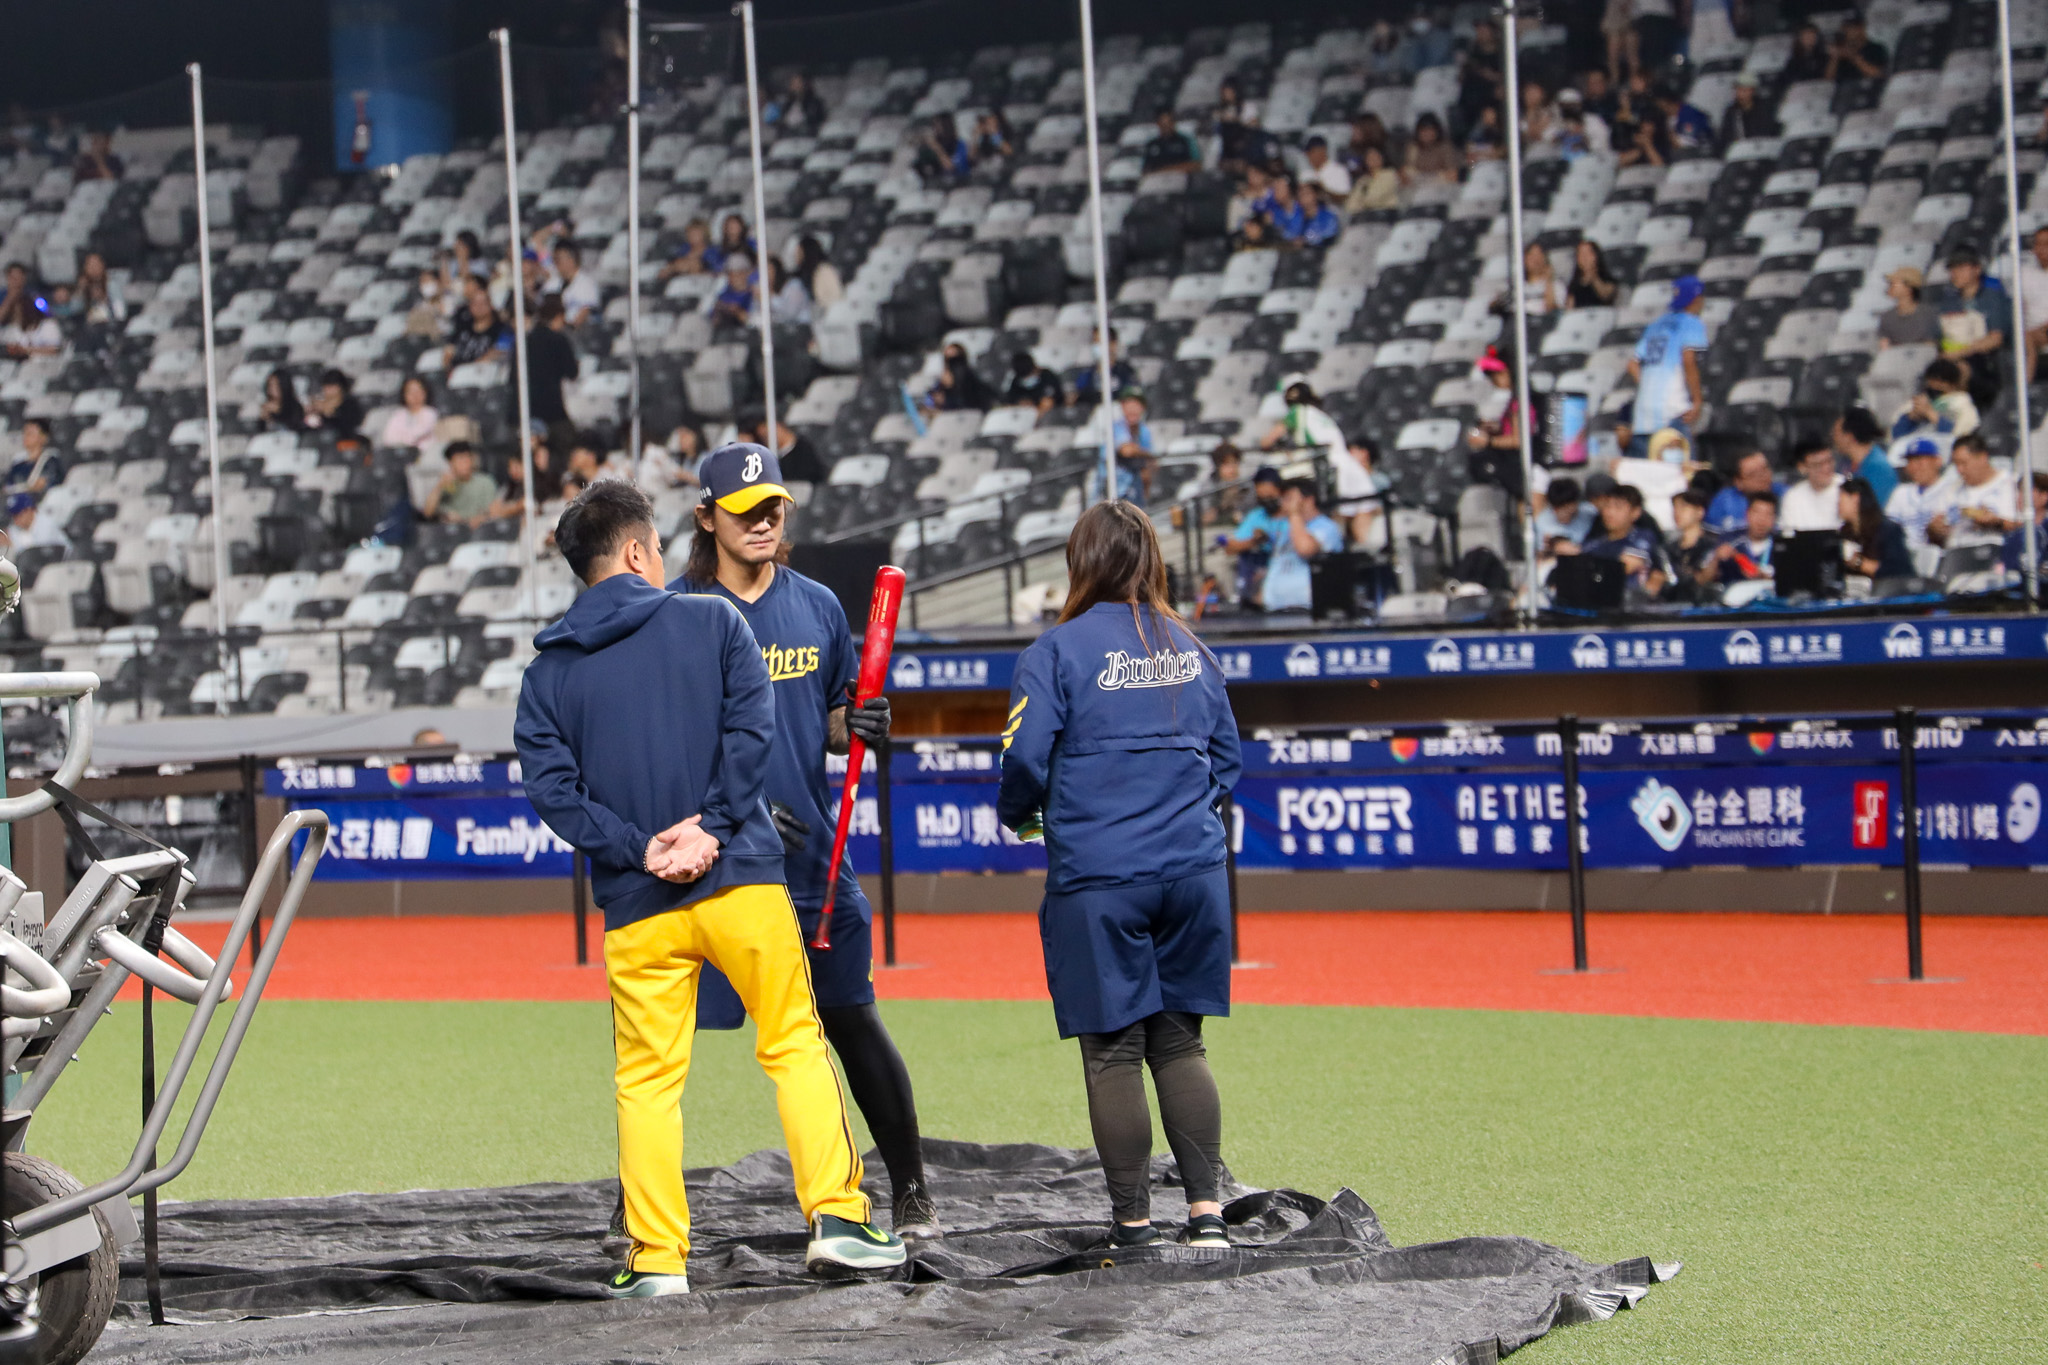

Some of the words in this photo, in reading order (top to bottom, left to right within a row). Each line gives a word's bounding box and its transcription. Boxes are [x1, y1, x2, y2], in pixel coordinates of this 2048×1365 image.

[742, 452, 763, 483] B
[1098, 649, 1202, 690] Brothers
[1279, 786, 1413, 832] FOOTER
[1457, 784, 1589, 821] AETHER
[1692, 786, 1806, 827] 台全眼科
